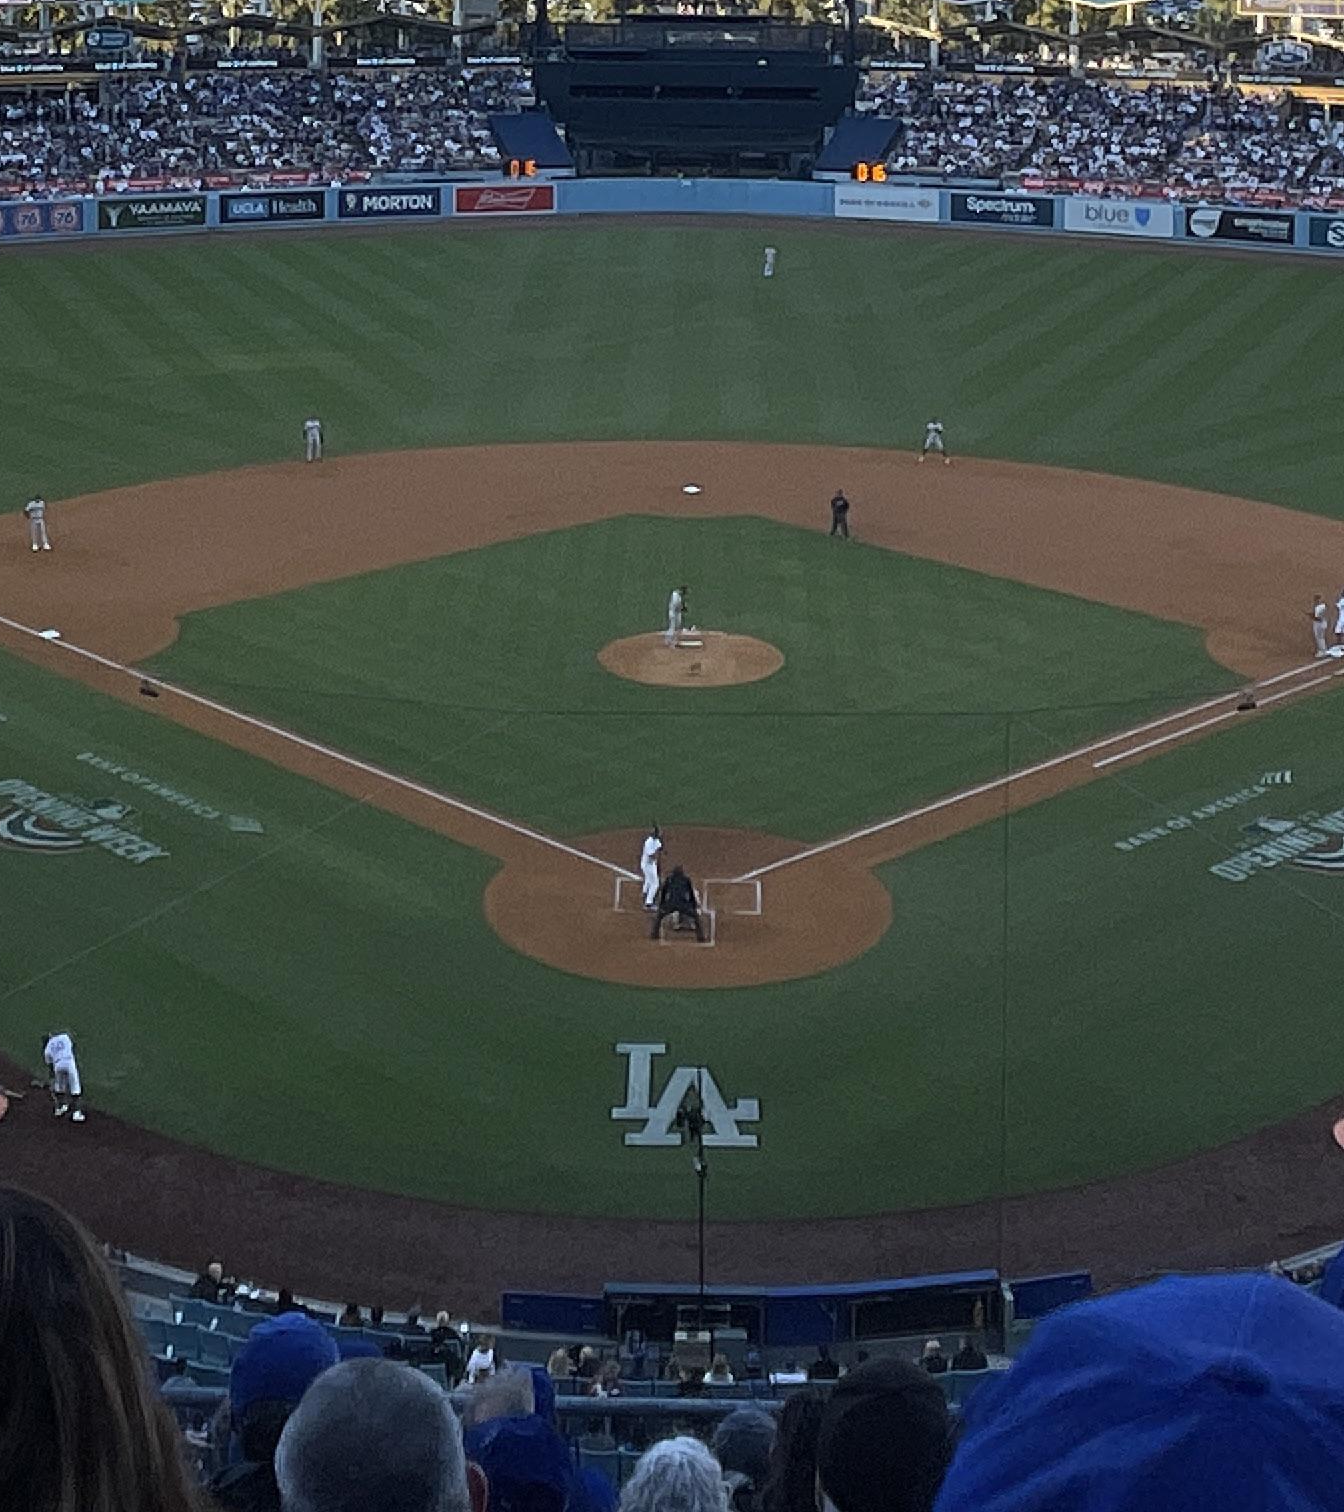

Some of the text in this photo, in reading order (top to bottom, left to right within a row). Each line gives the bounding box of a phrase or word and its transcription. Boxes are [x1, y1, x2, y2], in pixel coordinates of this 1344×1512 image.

[233, 203, 264, 215] UCLA
[362, 194, 433, 211] MORTON
[966, 196, 1035, 213] Spectrum
[1084, 202, 1129, 223] blue
[611, 1042, 760, 1148] LA
